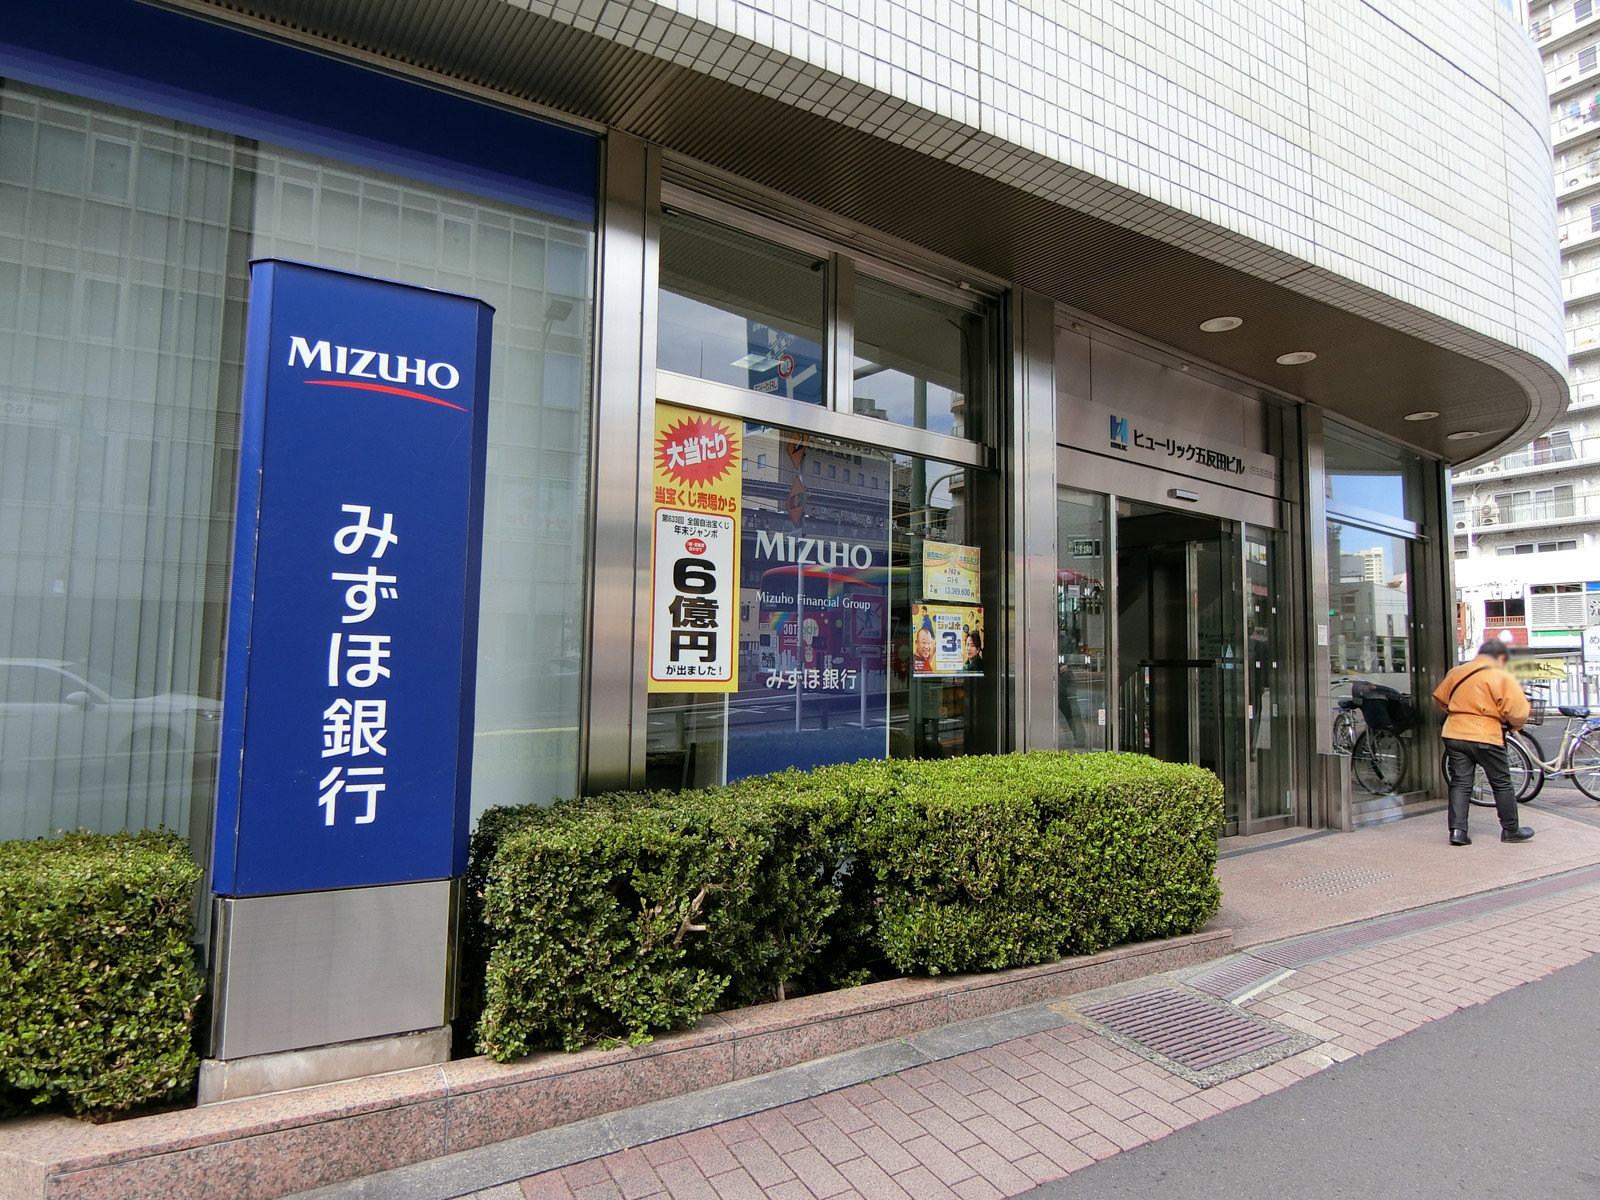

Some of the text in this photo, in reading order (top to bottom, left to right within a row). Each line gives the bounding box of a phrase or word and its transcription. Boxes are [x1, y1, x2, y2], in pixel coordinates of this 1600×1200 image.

[288, 336, 460, 390] MIZUHO
[666, 432, 727, 470] 大当たり
[1133, 429, 1246, 475] ヒューリック五反田ビル
[655, 486, 737, 513] 当宝くじ売場から
[674, 525, 719, 539] 年末ジャンボ
[687, 517, 730, 530] 全国自治宝くじ
[754, 529, 873, 570] MIZUHO
[668, 557, 720, 663] 6億円
[756, 590, 871, 612] Mizuho Financial Group
[318, 503, 399, 827] みずほ銀行
[765, 667, 858, 691] みずほ銀行
